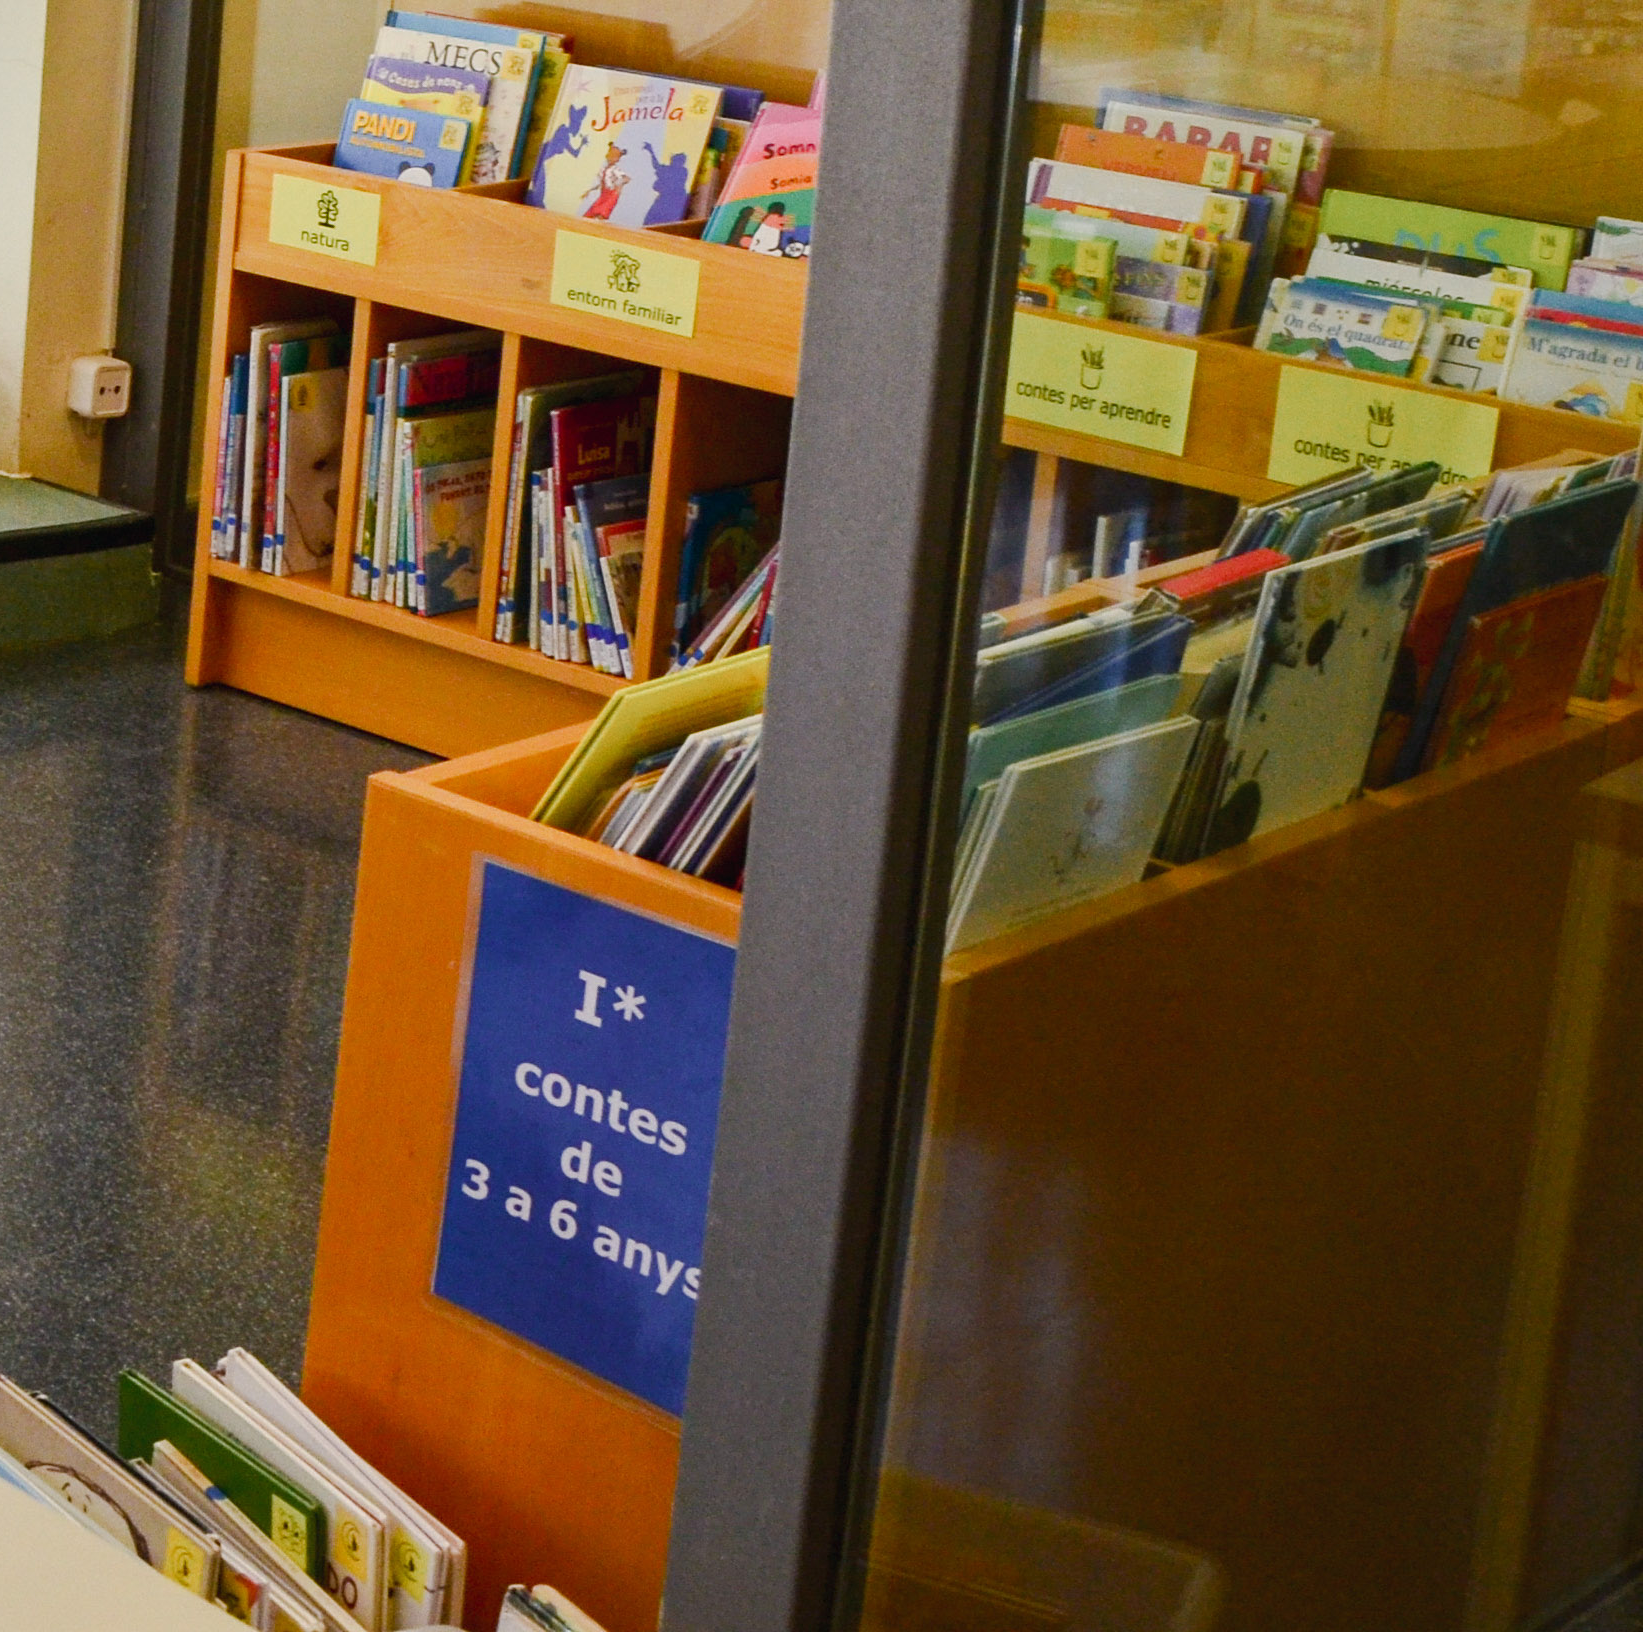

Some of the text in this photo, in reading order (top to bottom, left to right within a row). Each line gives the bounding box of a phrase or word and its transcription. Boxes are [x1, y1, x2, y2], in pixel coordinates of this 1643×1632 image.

[424, 41, 503, 76] MECS
[353, 110, 418, 145] PANDI
[591, 88, 684, 132] Jamela
[301, 231, 349, 252] natura
[567, 289, 682, 325] entorn familiar
[1526, 335, 1610, 367] M'agrada
[1613, 354, 1630, 370] el
[1016, 381, 1171, 429] contes per aprendre
[577, 443, 610, 466] Luisa
[1294, 439, 1351, 463] contes
[1356, 451, 1386, 470] per
[515, 1061, 688, 1156] contes
[560, 1141, 623, 1197] de
[461, 1158, 702, 1301] 3 a 6 anys
